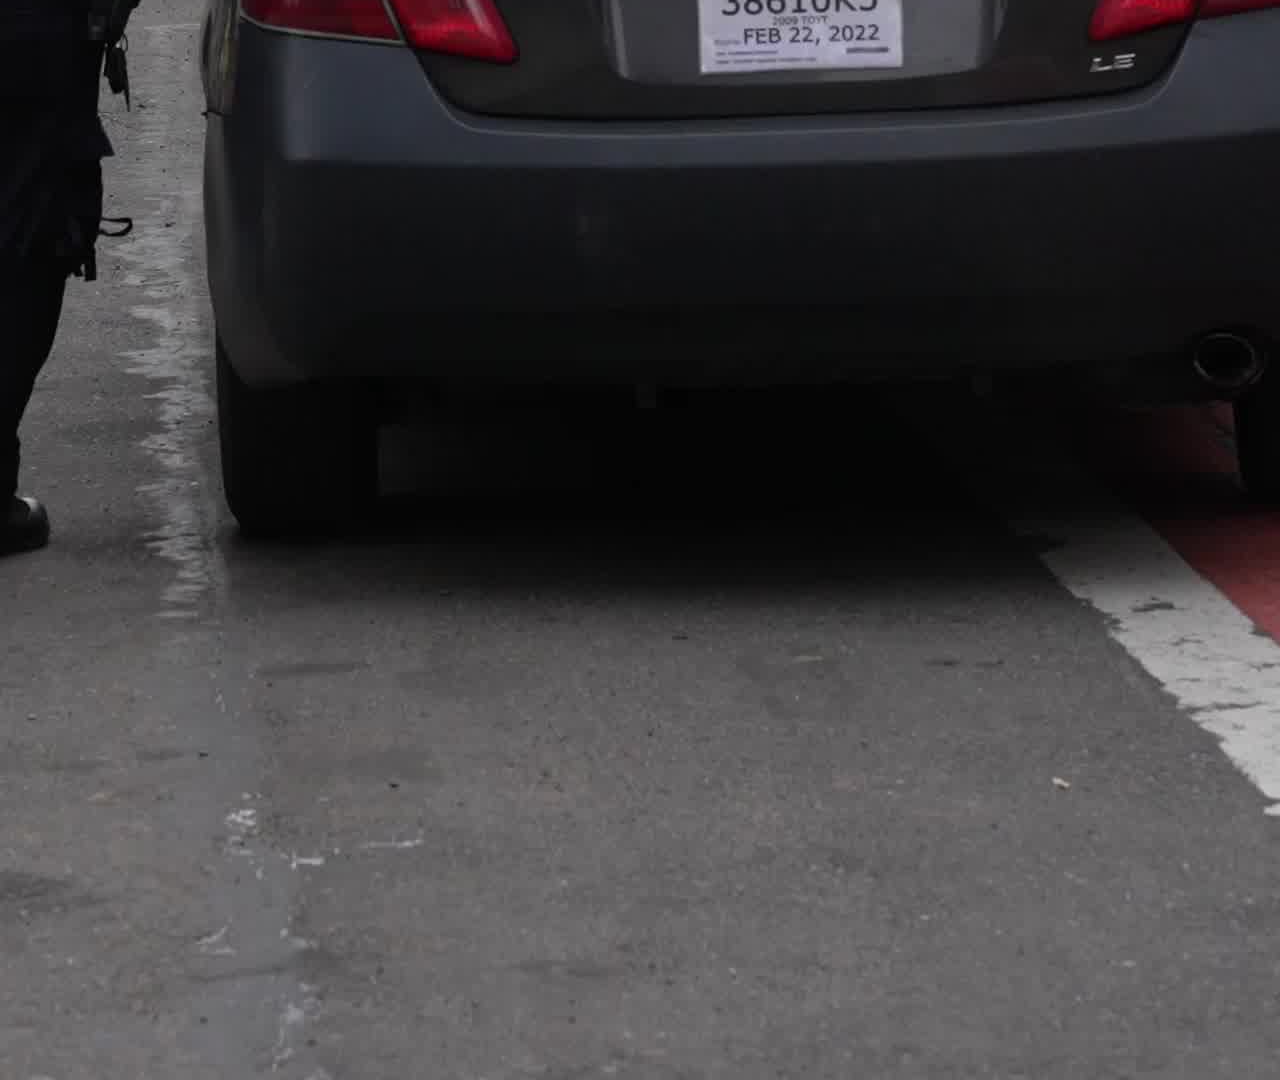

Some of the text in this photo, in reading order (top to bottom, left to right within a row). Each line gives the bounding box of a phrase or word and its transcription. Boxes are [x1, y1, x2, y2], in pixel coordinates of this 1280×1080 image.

[743, 24, 880, 46] FEB 22, 2022
